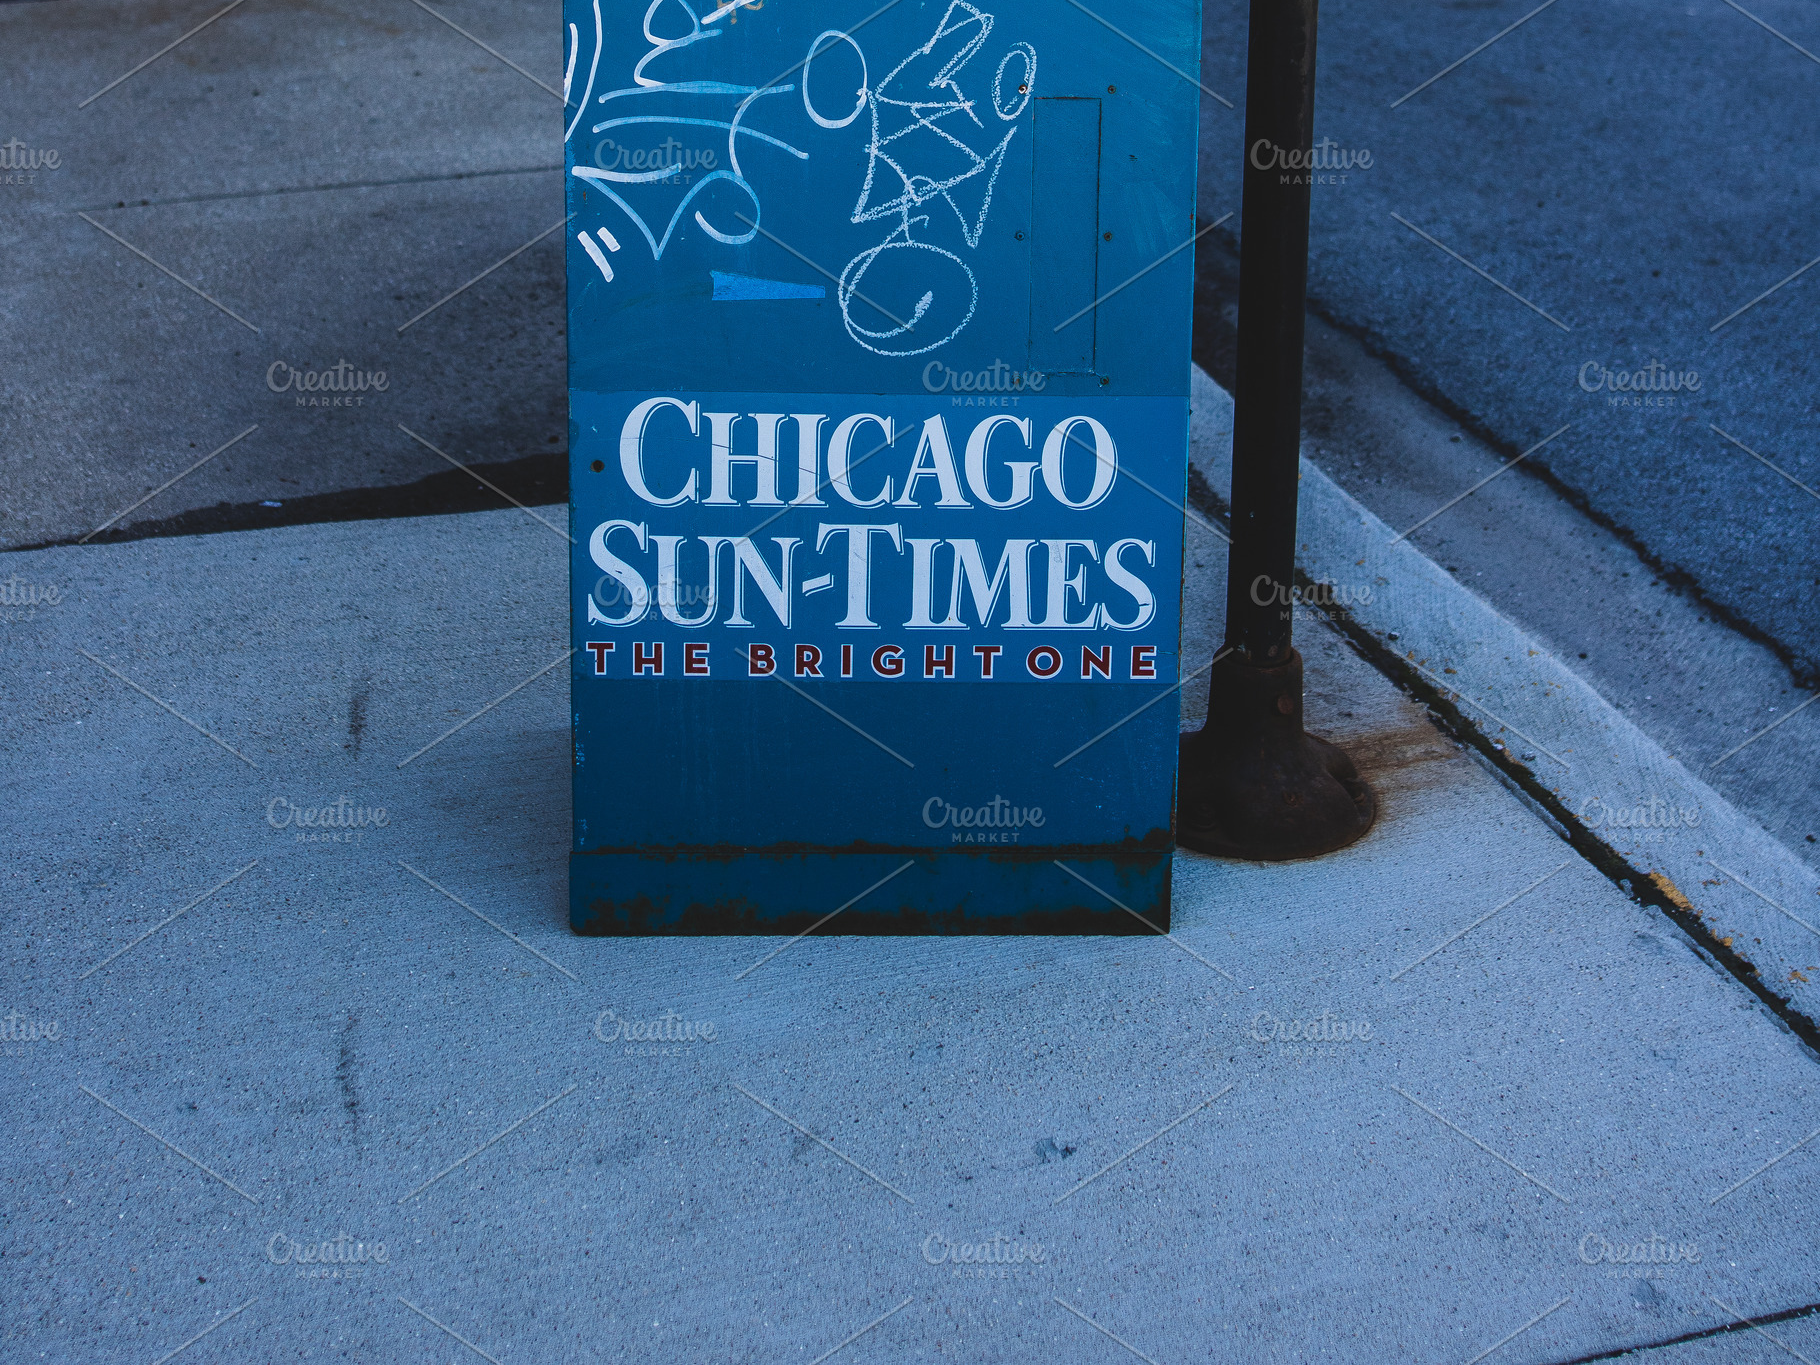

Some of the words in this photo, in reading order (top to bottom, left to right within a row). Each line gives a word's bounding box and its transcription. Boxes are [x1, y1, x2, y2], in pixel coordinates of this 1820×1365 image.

[619, 396, 1119, 511] CHICAGO
[586, 519, 1157, 632] SUN-TIMES
[586, 641, 711, 676] THE
[748, 643, 1003, 678] BRIGHT
[1025, 645, 1158, 680] ONE
